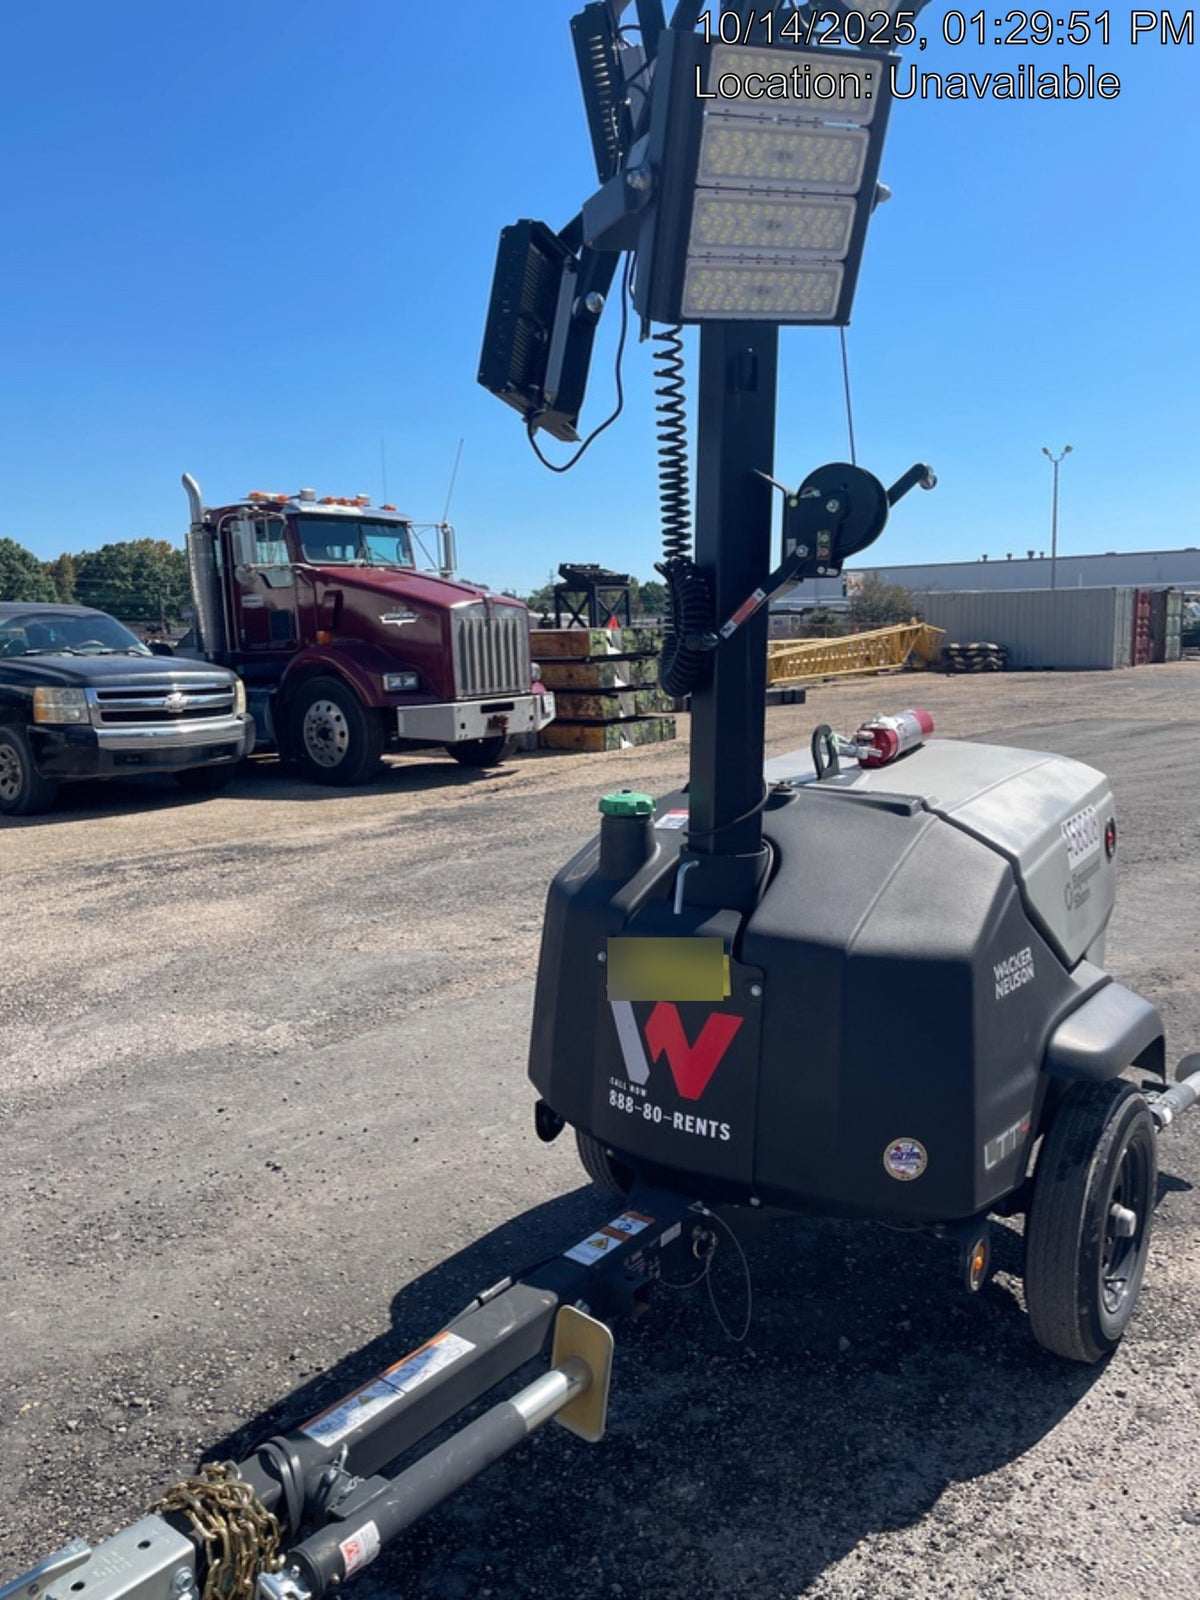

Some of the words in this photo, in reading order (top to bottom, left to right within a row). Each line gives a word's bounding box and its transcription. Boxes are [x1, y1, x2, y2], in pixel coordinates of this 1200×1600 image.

[993, 946, 1033, 982] WACKER
[995, 963, 1035, 1001] NEUSON
[629, 1085, 648, 1097] NOW
[608, 1089, 731, 1141] 888-80-RENTS
